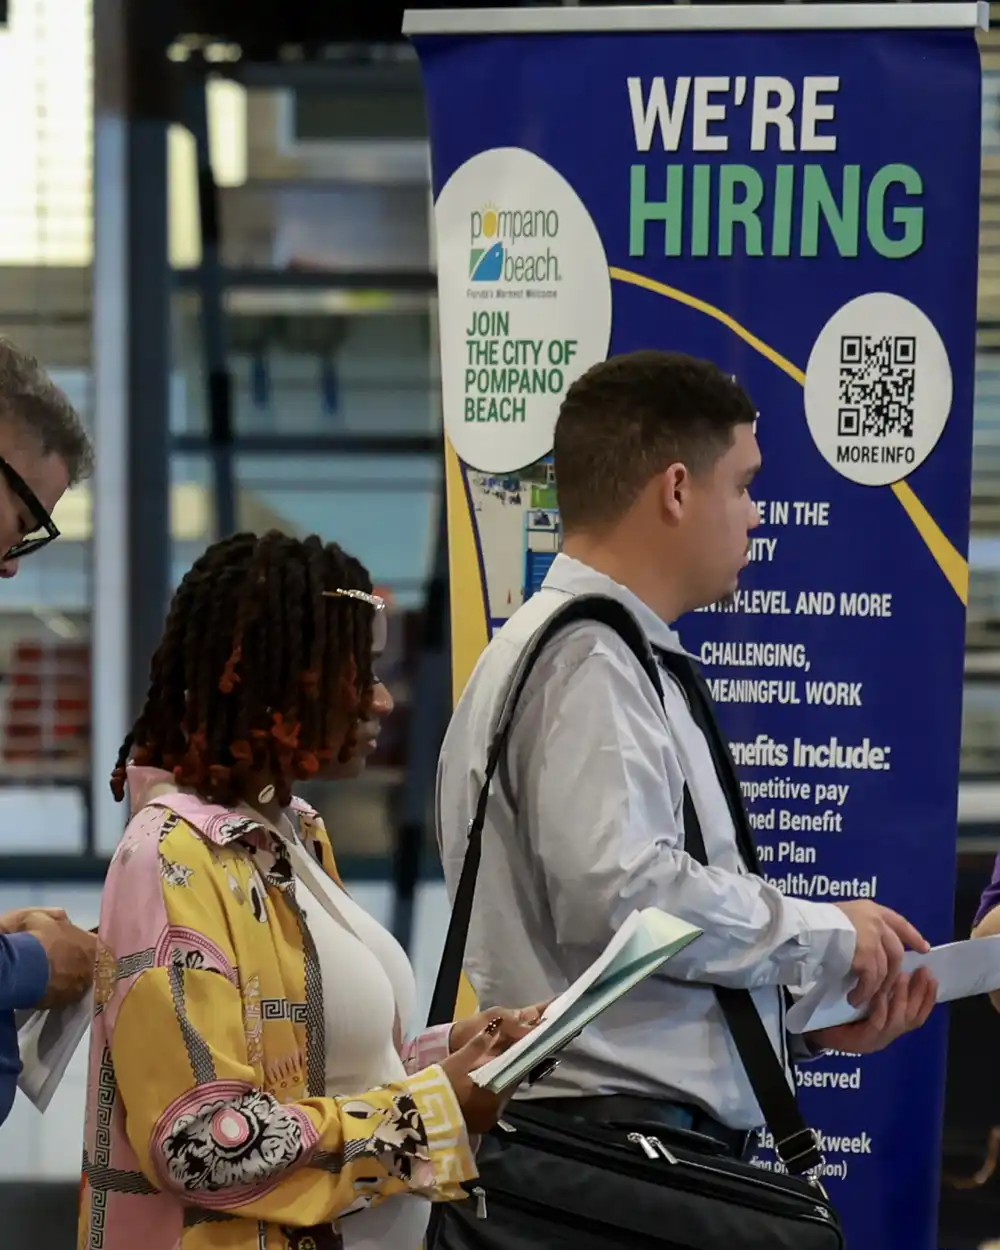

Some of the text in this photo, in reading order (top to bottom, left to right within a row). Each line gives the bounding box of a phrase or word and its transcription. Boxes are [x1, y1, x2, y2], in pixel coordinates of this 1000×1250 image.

[627, 76, 840, 152] WE'RE
[470, 204, 560, 245] pompano
[628, 164, 924, 259] HIRING
[466, 311, 510, 337] JOIN
[466, 340, 578, 366] THE CITY OF
[465, 368, 564, 394] POMPANO
[464, 397, 526, 423] BEACH
[836, 445, 915, 464] MORE INFO
[769, 501, 789, 525] IN
[793, 502, 830, 526] THE
[746, 538, 777, 562] ITY
[794, 591, 836, 616] AND
[839, 592, 892, 618] MORE
[700, 641, 811, 672] CHALLENGING,
[705, 678, 863, 706] MEANINGFUL WORK
[793, 736, 892, 771] Include:
[815, 783, 850, 807] pay
[746, 808, 843, 833] ned Benefit
[777, 840, 817, 864] Plan
[764, 872, 878, 899] ealth/Dental
